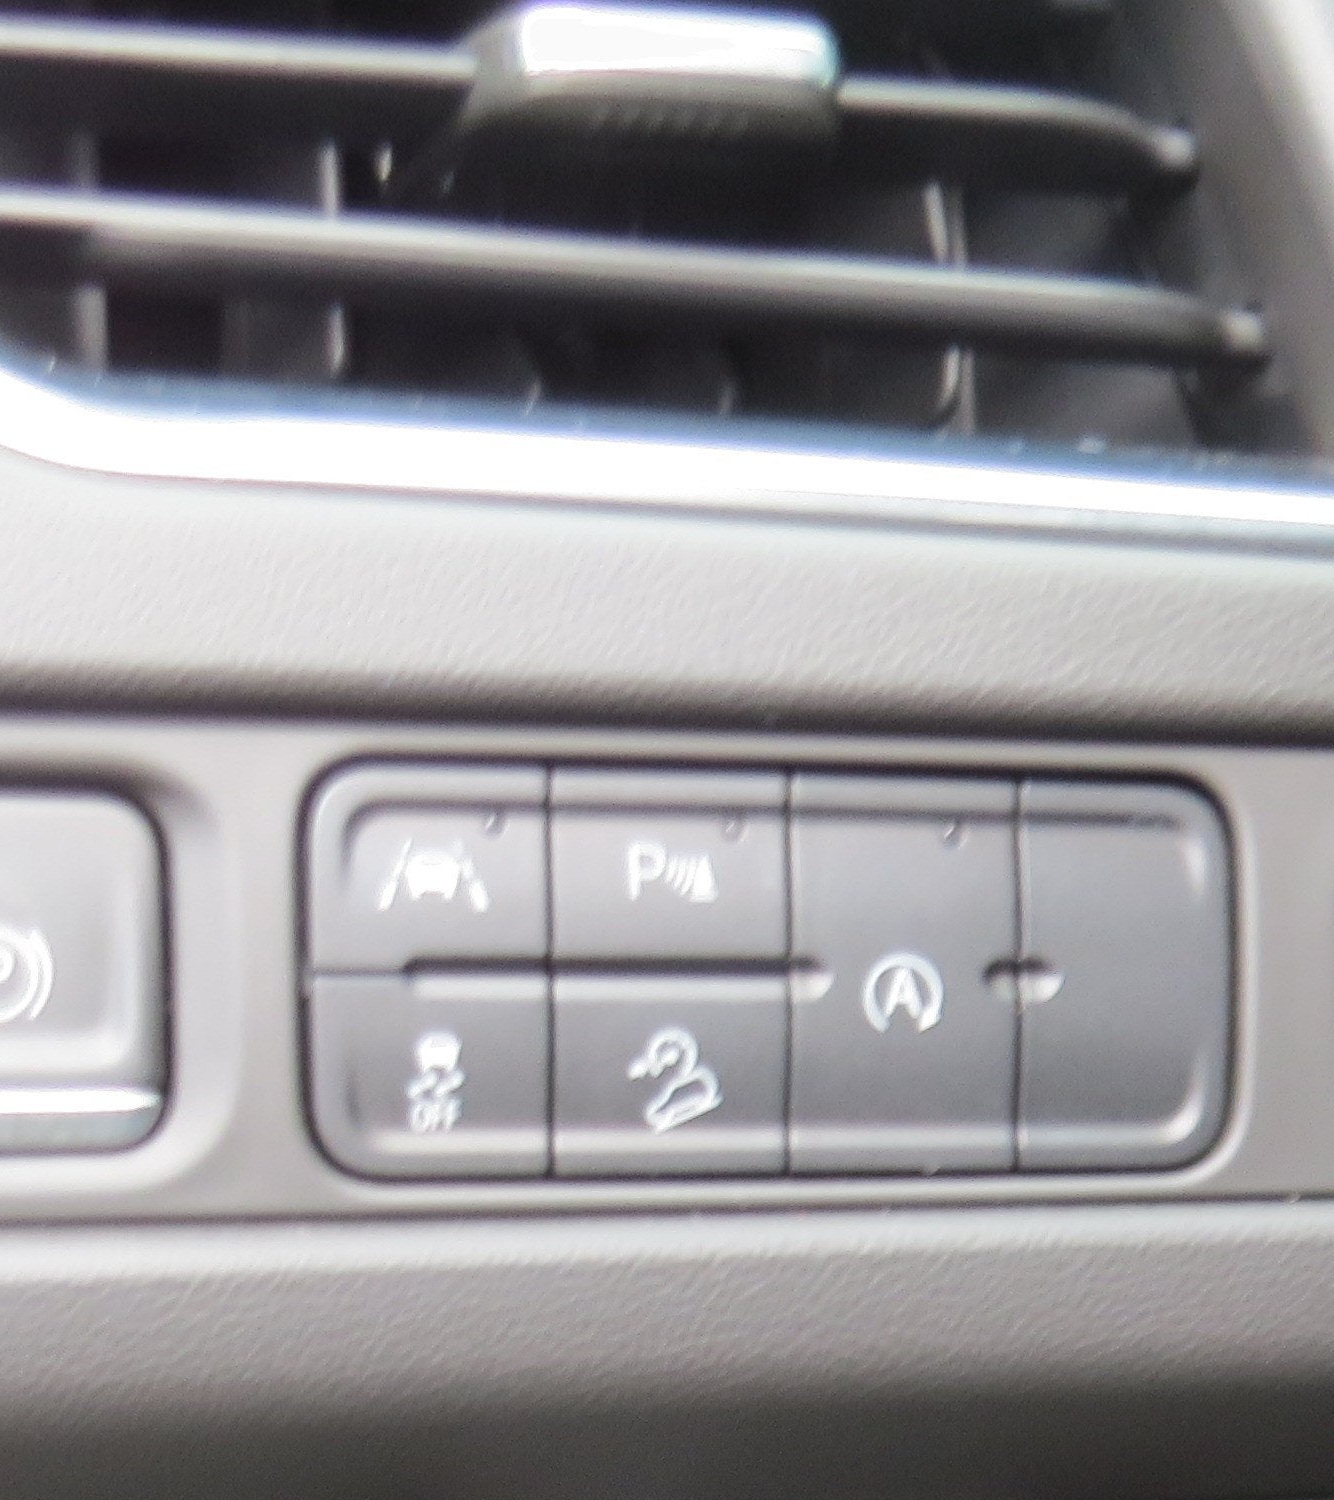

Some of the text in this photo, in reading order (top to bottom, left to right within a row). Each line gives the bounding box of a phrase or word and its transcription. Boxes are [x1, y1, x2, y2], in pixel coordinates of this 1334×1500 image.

[627, 841, 667, 901] P
[884, 967, 921, 1019] A
[410, 1100, 460, 1132] OFF
